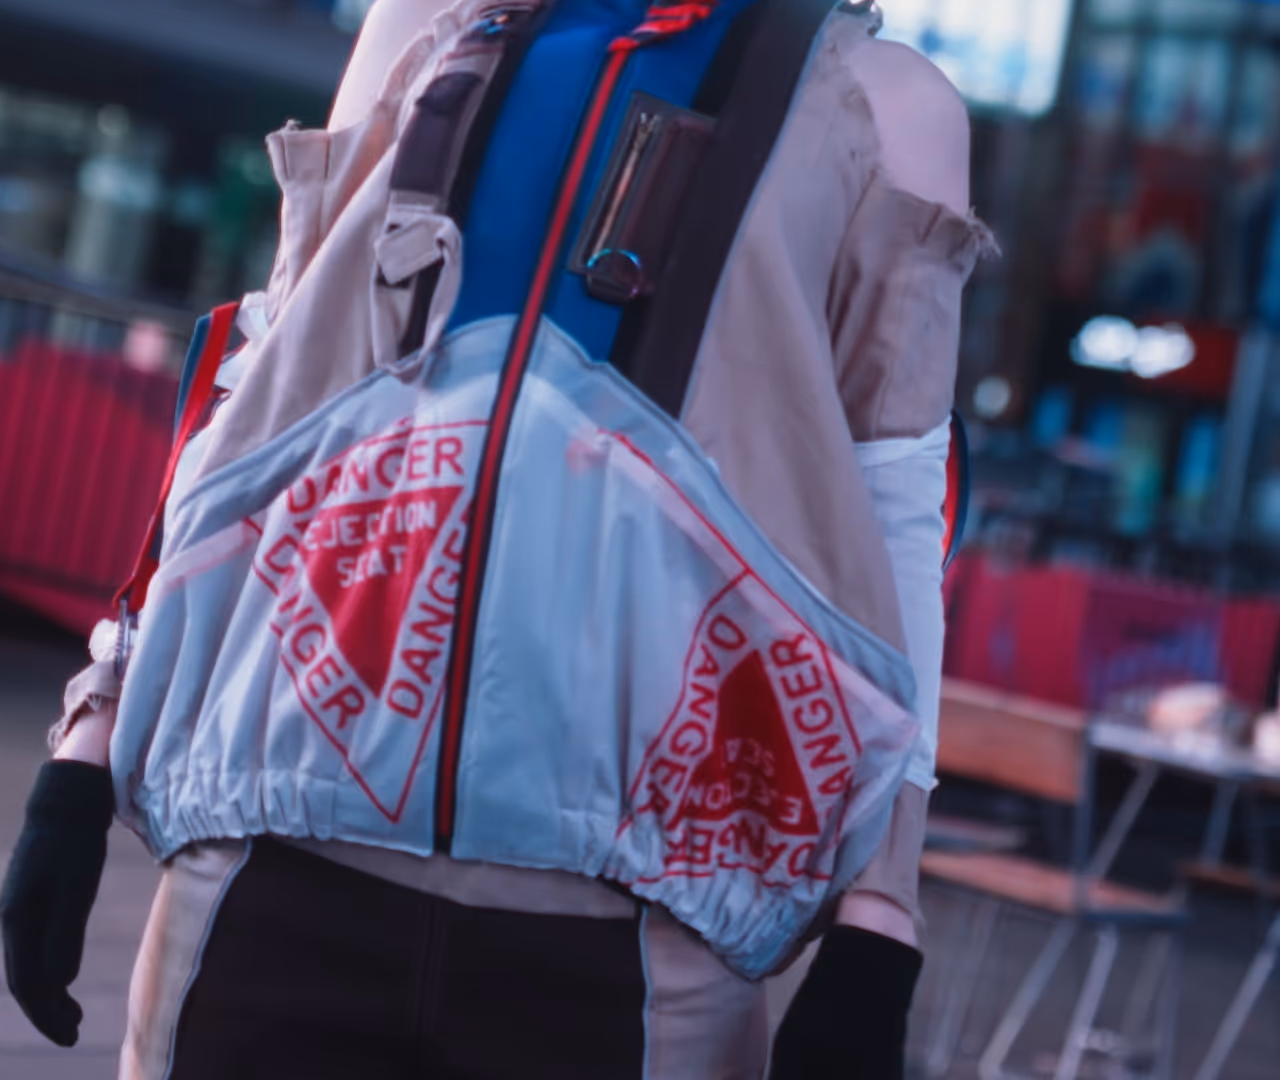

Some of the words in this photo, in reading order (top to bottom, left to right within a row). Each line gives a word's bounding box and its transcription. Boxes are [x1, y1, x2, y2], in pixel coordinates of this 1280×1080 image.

[287, 436, 465, 513] DANGER
[303, 500, 437, 551] EJECTION
[264, 535, 366, 729] DNGER
[386, 508, 470, 719] DANGE
[637, 613, 747, 814] DANGER
[684, 771, 802, 825] EECION
[768, 630, 852, 800] ANGER
